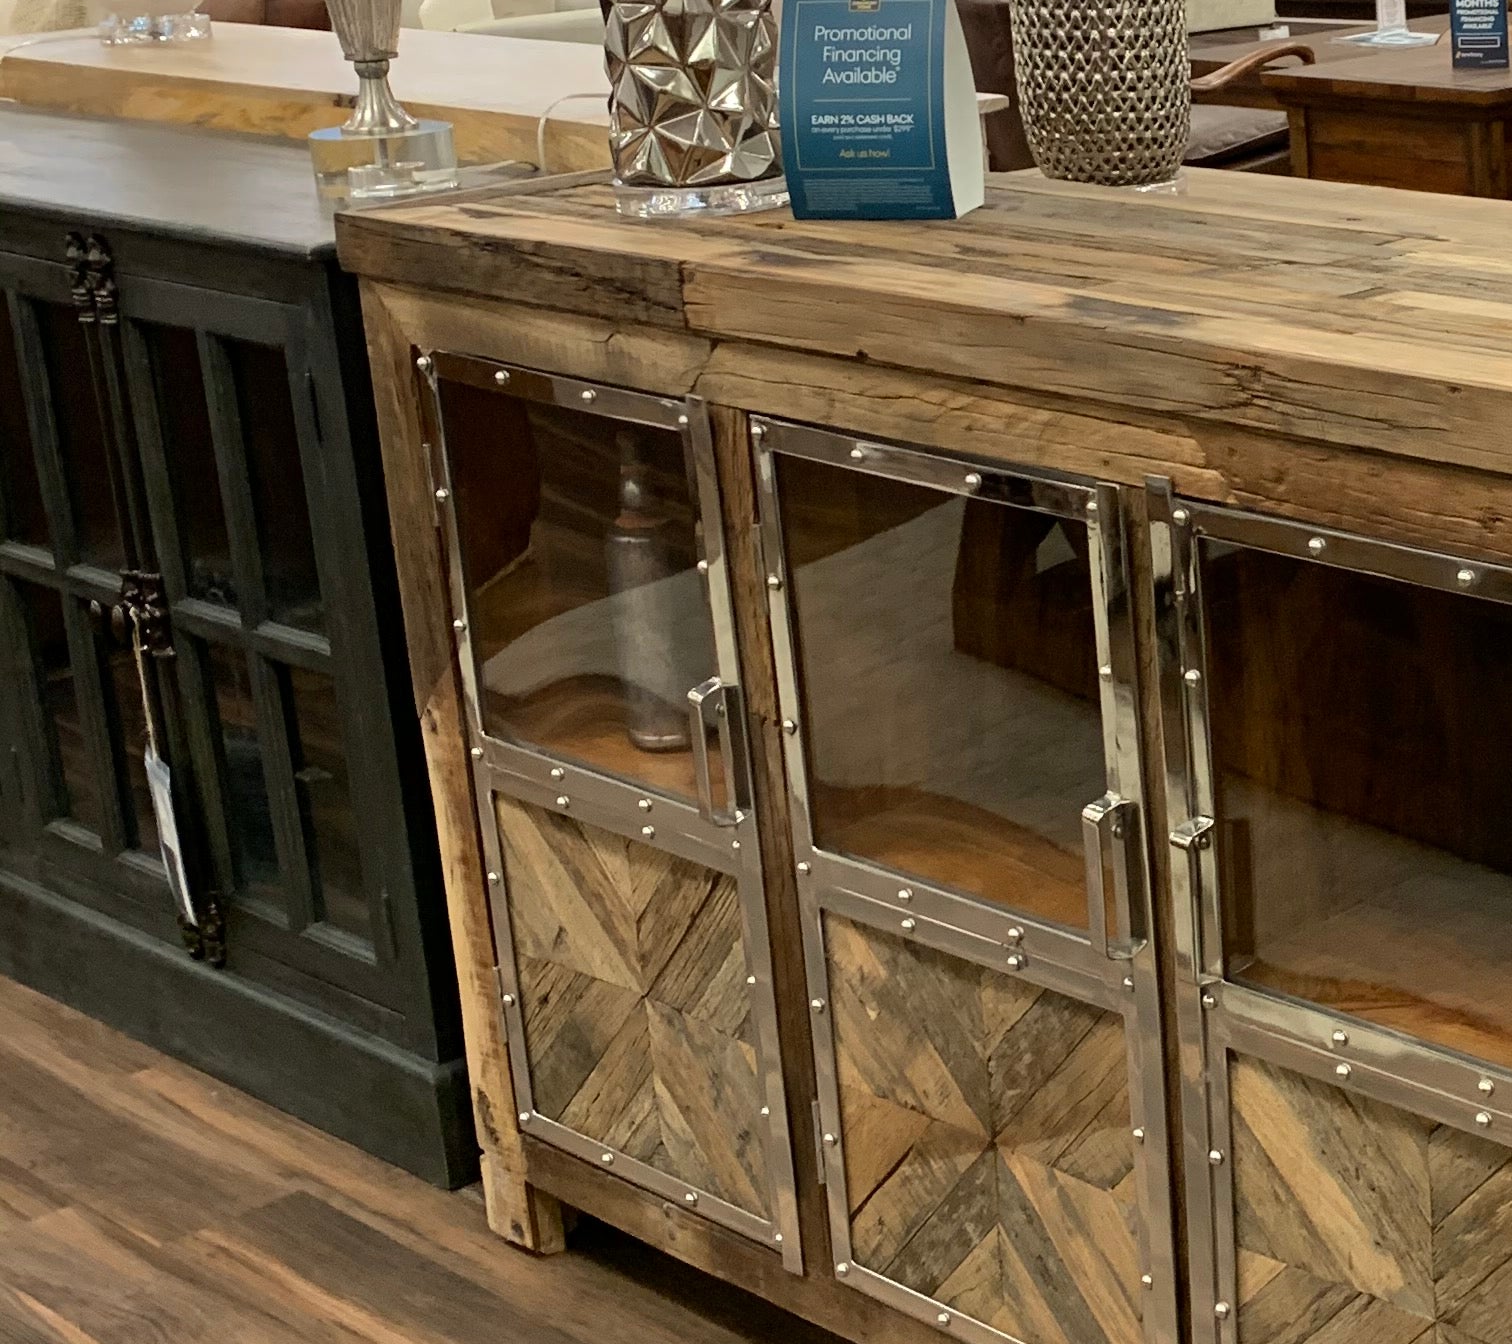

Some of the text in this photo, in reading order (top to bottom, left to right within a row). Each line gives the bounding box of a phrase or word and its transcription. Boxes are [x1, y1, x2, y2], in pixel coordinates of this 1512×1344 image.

[814, 23, 912, 41] Promotional
[823, 46, 901, 65] Financing
[811, 114, 914, 125] EARN 2% CASH BACK
[840, 126, 872, 134] purchase
